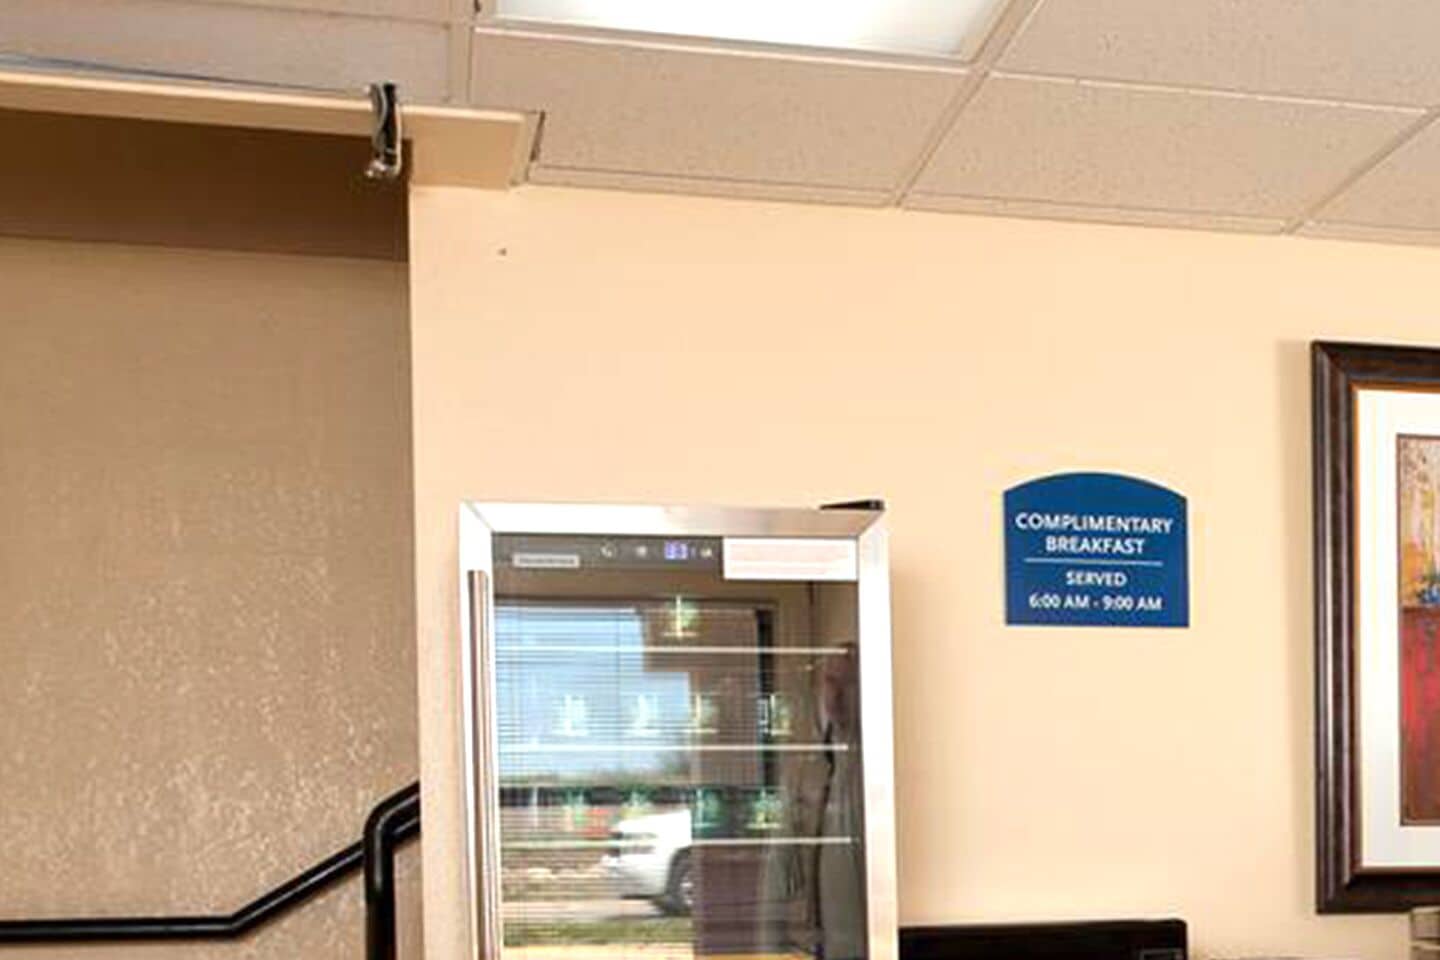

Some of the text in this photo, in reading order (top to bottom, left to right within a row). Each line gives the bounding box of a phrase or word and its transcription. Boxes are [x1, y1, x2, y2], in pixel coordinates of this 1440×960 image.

[1015, 512, 1173, 533] COMPLIMENTARY
[1045, 536, 1145, 554] BREAKFAST
[1066, 571, 1127, 586] SERVED
[1028, 593, 1060, 609] 6:00
[1063, 595, 1089, 608] AM
[1103, 596, 1133, 611] 9:00
[1136, 597, 1162, 610] AM
